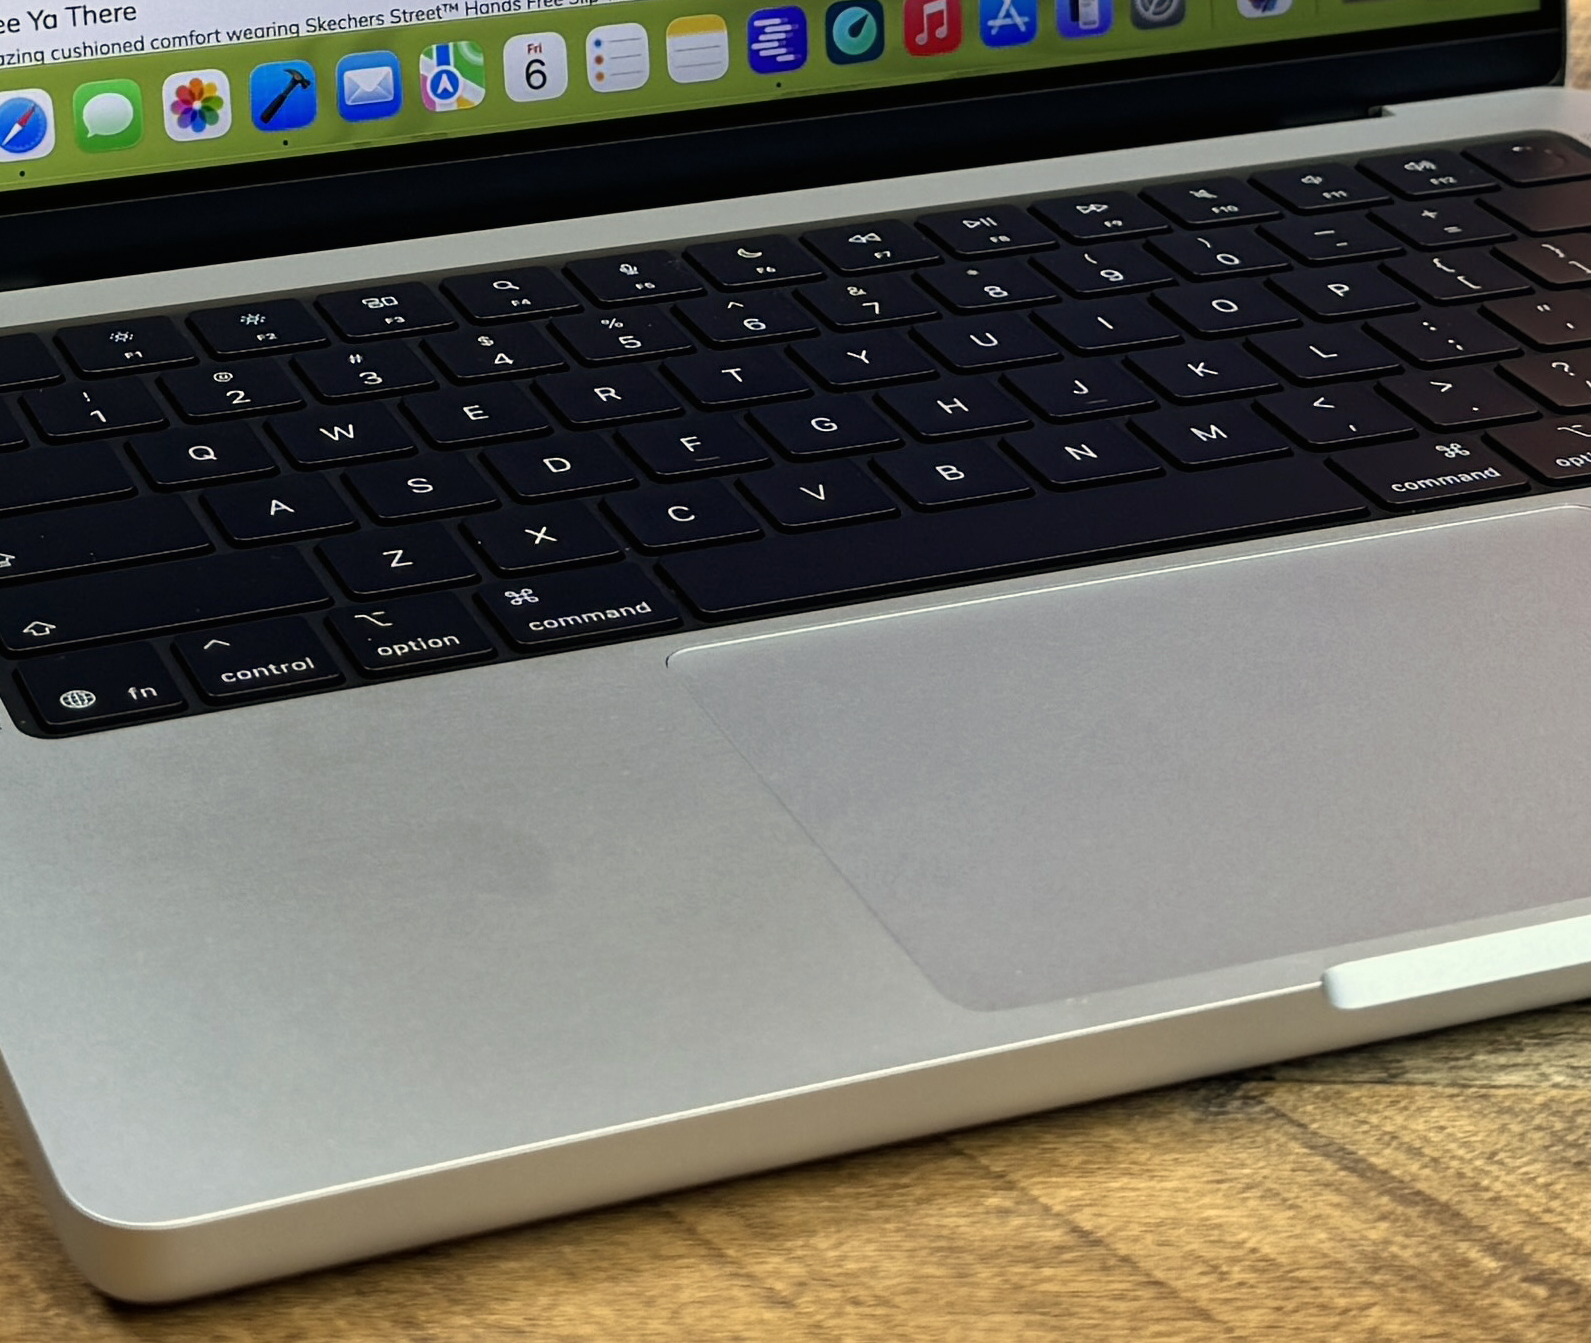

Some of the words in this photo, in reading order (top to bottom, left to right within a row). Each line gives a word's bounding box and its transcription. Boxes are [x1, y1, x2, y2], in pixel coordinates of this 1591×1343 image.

[26, 9, 57, 31] Ya
[64, 4, 136, 27] There
[51, 35, 144, 60] cushioned
[150, 30, 221, 50] comfort
[226, 22, 300, 42] wearing
[306, 15, 384, 33] Skechers
[464, 0, 522, 16] Hands
[527, 43, 542, 55] Fri
[524, 59, 548, 89] 6
[1328, 284, 1349, 296] P
[1212, 300, 1238, 312] O
[1098, 317, 1113, 329] I
[970, 333, 998, 346] U
[847, 350, 869, 363] Y
[1310, 346, 1337, 358] L
[722, 368, 742, 382] T
[1188, 362, 1218, 376] K
[594, 387, 621, 401] R
[1074, 380, 1088, 394] J
[463, 405, 488, 420] E
[937, 398, 968, 413] H
[320, 424, 354, 440] W
[811, 418, 837, 431] G
[1191, 425, 1227, 441] M
[680, 437, 700, 451] F
[189, 446, 217, 460] Q
[1065, 444, 1097, 460] N
[543, 458, 571, 472] D
[936, 466, 964, 480] B
[1392, 468, 1500, 491] command
[408, 478, 433, 493] S
[800, 485, 825, 500] V
[271, 500, 294, 515] A
[668, 506, 695, 521] C
[525, 527, 556, 544] X
[383, 550, 412, 567] Z
[528, 601, 652, 631] command
[378, 636, 459, 655] option
[222, 658, 314, 682] control
[128, 688, 157, 699] fn
